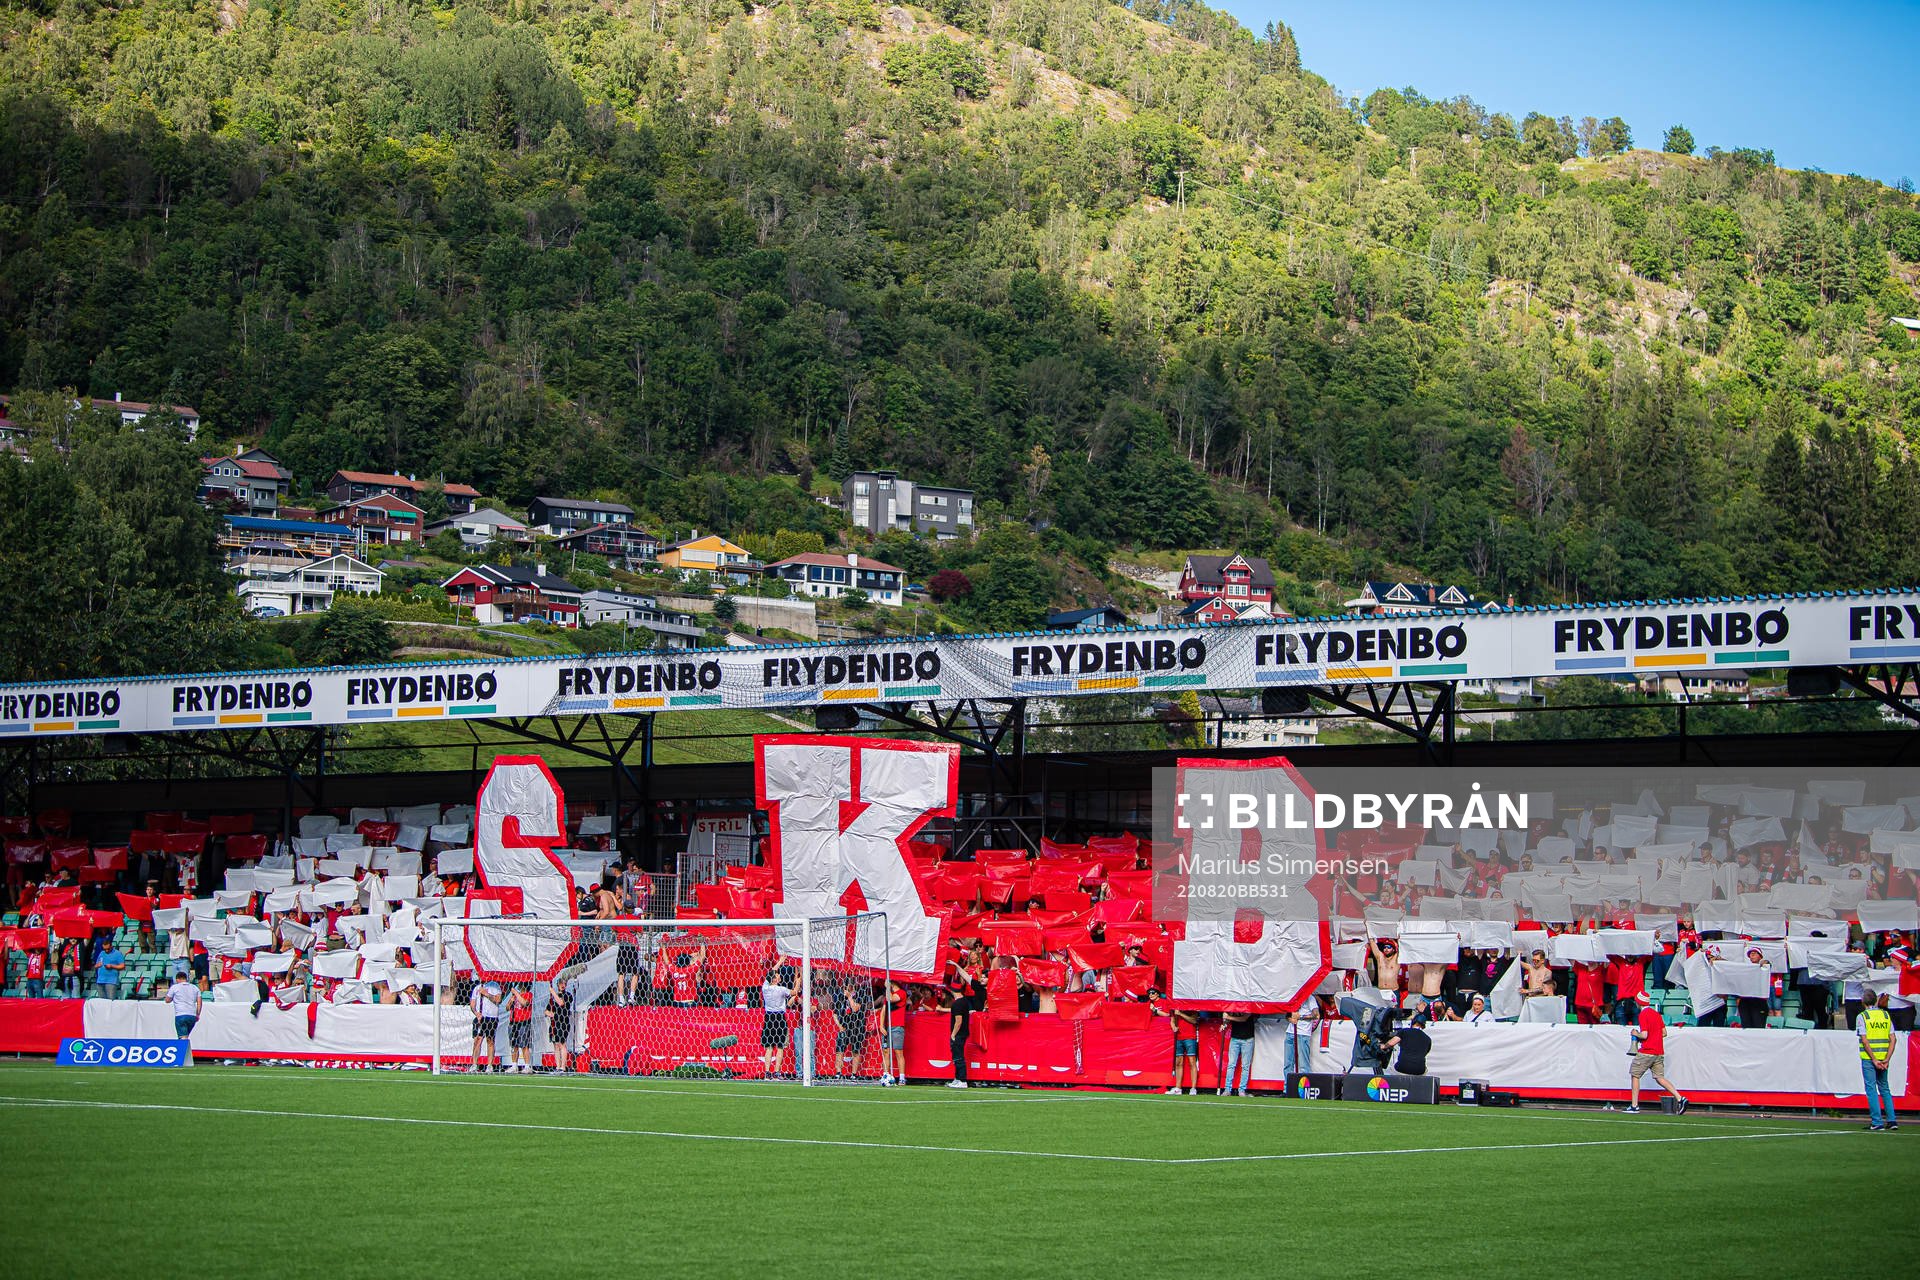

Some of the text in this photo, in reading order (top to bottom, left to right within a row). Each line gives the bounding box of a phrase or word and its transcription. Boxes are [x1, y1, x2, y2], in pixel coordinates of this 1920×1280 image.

[1256, 622, 1468, 664] FRYDENBØ
[1555, 606, 1789, 652] FRYDENBØ
[764, 648, 941, 688] FRYDENBØ
[1012, 634, 1206, 676] FRYDENBØ
[347, 672, 497, 705] FRYDENBØ
[558, 658, 722, 696] FRYDENBØ
[0, 688, 120, 720] RYDENBØ
[172, 678, 312, 712] FRYDENBØ
[698, 820, 743, 833] STRIL
[108, 1046, 178, 1064] OBOS
[1304, 1087, 1320, 1100] NEP
[1379, 1088, 1409, 1102] NEP
